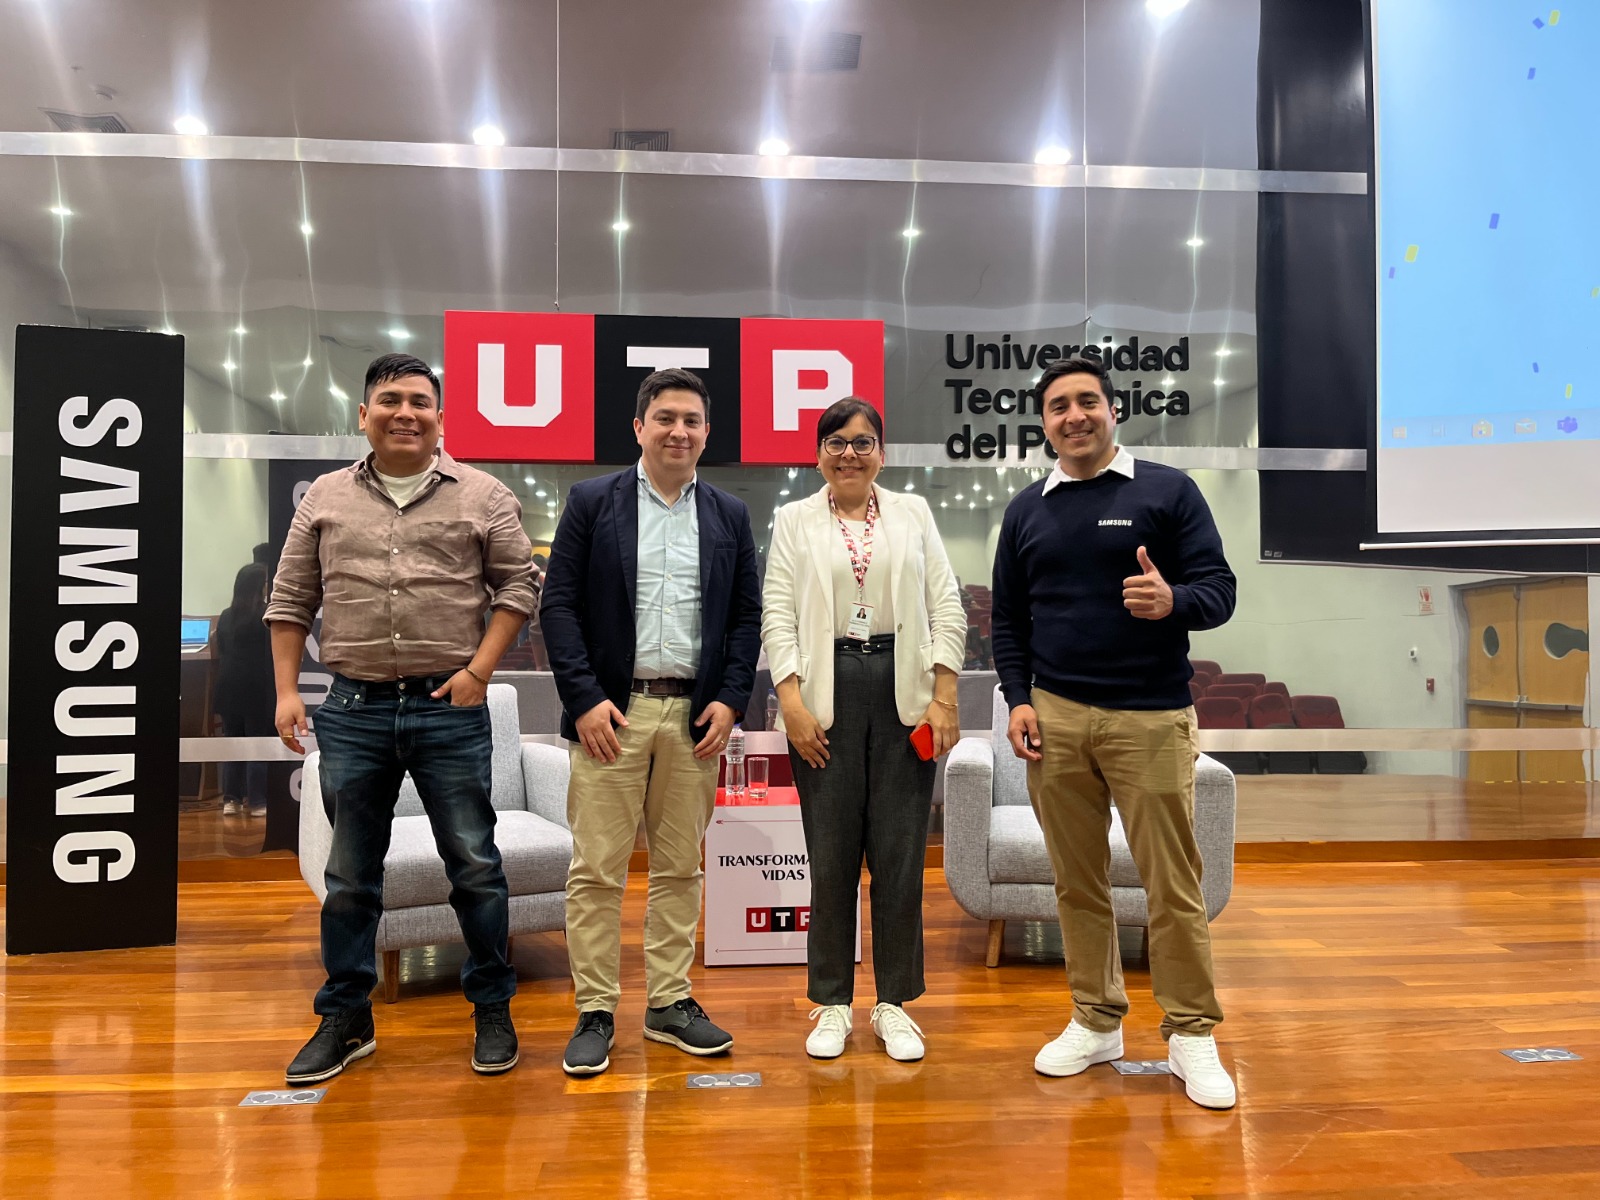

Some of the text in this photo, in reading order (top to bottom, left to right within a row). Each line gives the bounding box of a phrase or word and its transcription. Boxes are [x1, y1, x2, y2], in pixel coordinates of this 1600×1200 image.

[945, 334, 1190, 372] Universidad
[945, 379, 1190, 424] Tecngica
[946, 424, 1007, 459] del
[1097, 519, 1133, 527] SAMSUNG
[53, 396, 143, 884] SAMSUNG
[718, 854, 809, 867] TRANSFORM
[762, 869, 805, 881] VIDAS
